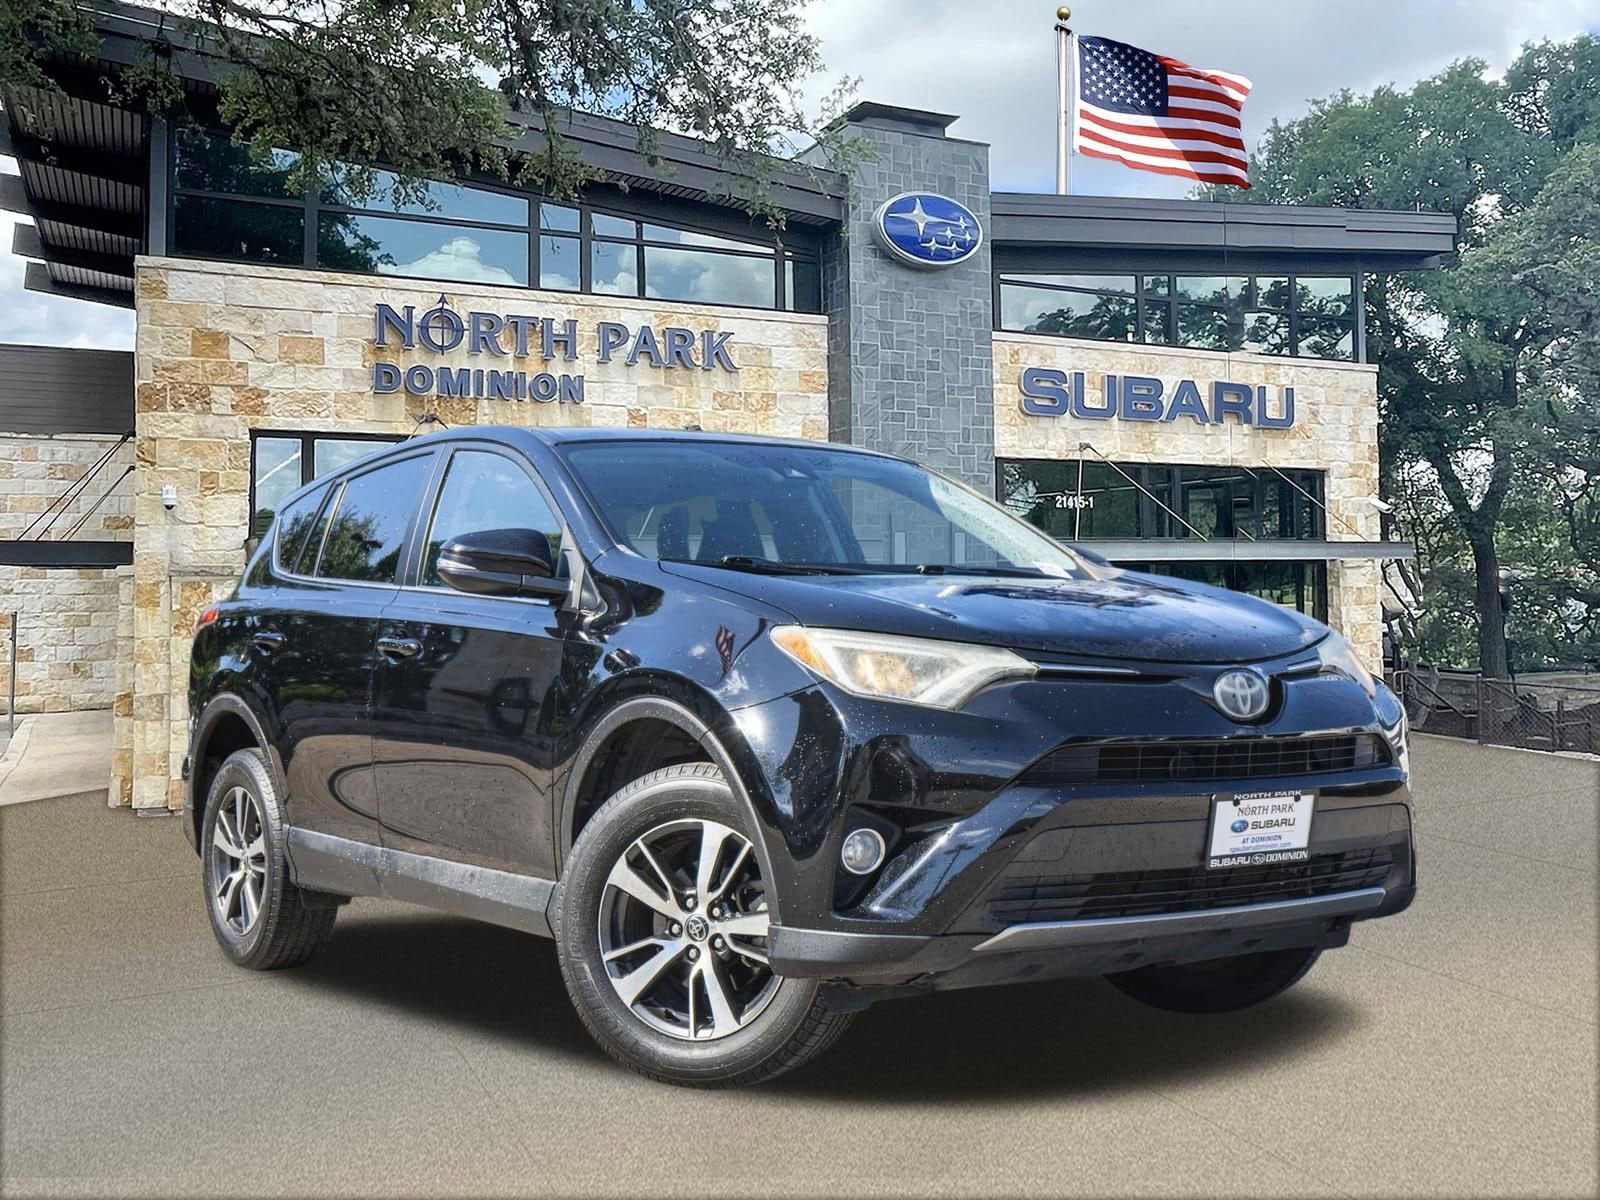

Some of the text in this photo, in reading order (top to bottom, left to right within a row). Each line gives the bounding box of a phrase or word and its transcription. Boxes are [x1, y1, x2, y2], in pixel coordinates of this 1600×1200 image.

[374, 299, 741, 373] NORTH PARK
[373, 362, 585, 404] DOMINION
[1019, 367, 1295, 429] SUBARU
[1233, 790, 1302, 801] NORTH PARK
[1237, 803, 1295, 817] NORTH PARK
[1250, 818, 1296, 830] SUBARU
[1251, 834, 1283, 843] DOMINION
[1210, 850, 1309, 868] SUBARU DOMINION
